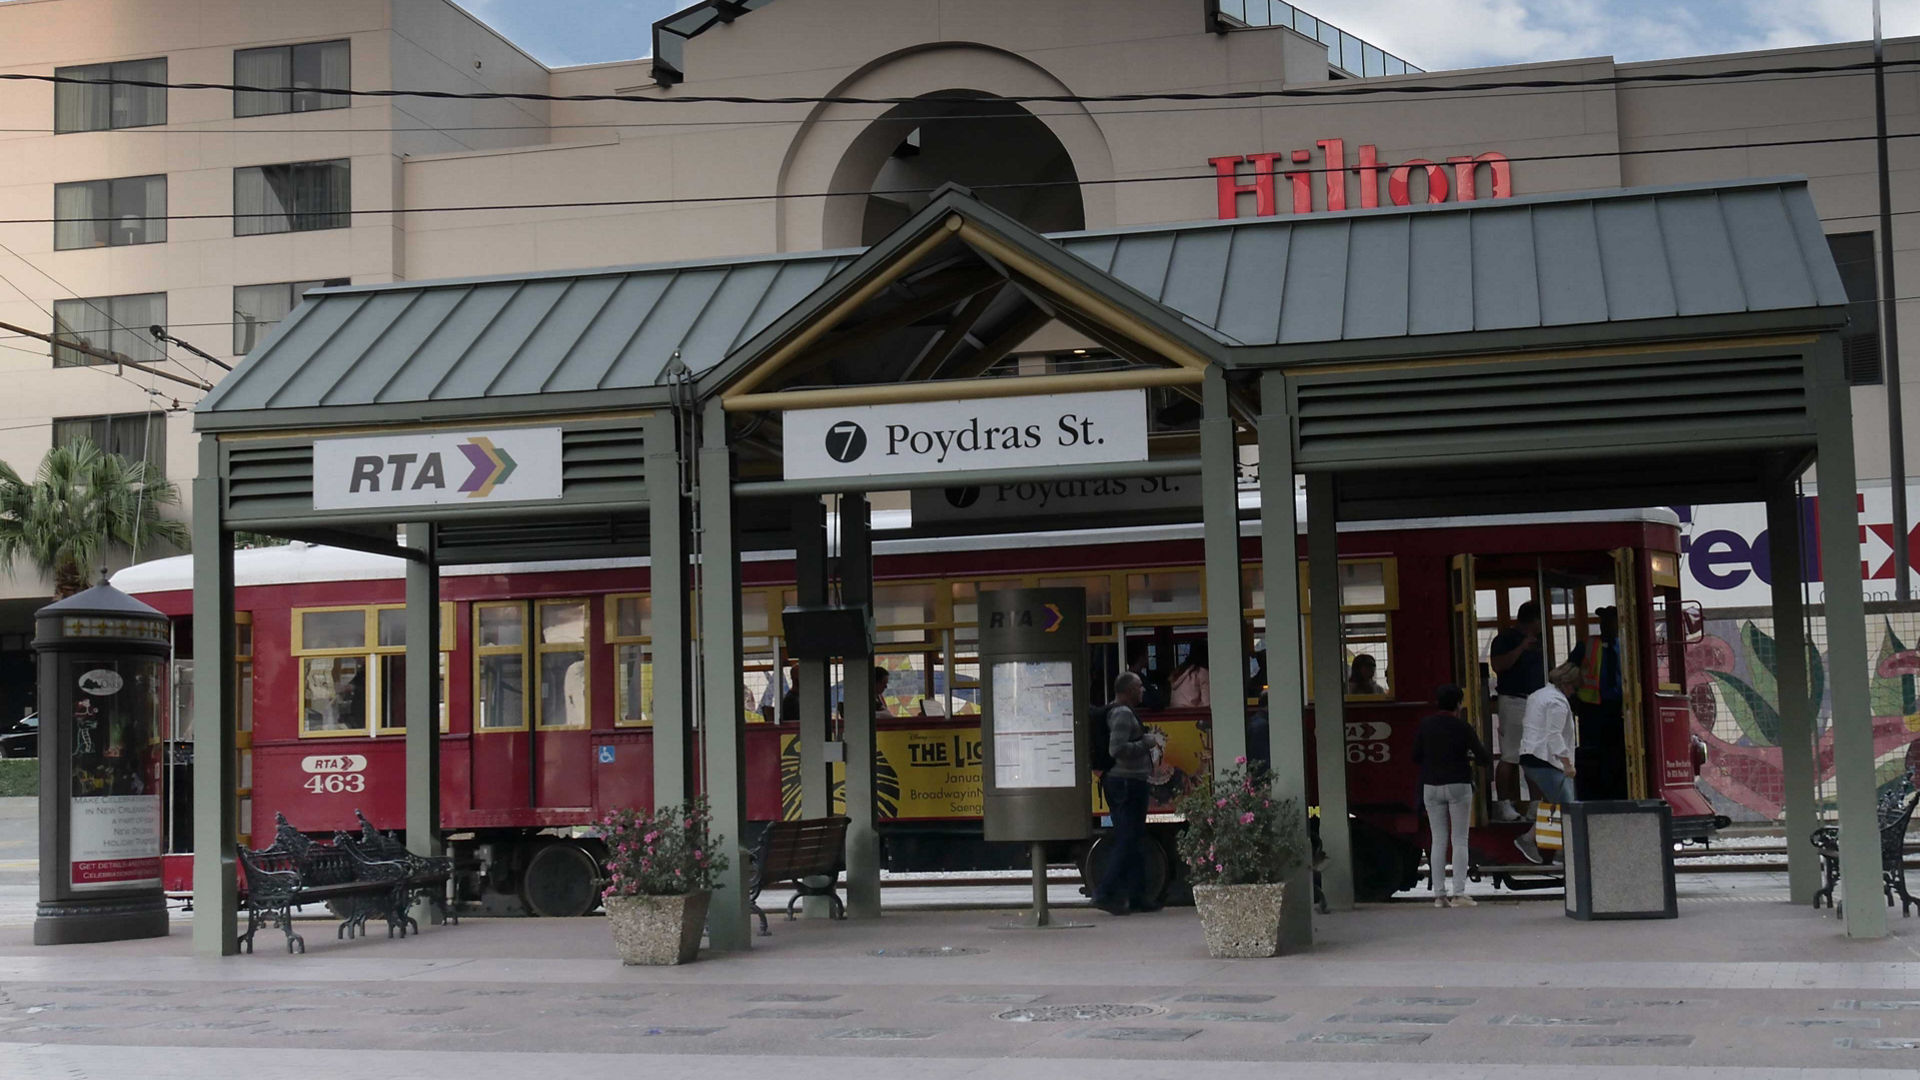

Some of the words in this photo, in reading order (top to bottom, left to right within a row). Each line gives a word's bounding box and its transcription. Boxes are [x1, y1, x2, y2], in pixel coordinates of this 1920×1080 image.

[1208, 138, 1511, 220] Hilton
[886, 418, 1041, 463] Poydras
[1057, 414, 1105, 447] St.
[349, 452, 446, 493] RTA
[989, 610, 1033, 629] RTA
[908, 743, 947, 762] THE
[1346, 743, 1391, 763] 63
[314, 759, 338, 769] RTA
[303, 773, 366, 794] 463
[79, 863, 96, 871] GET
